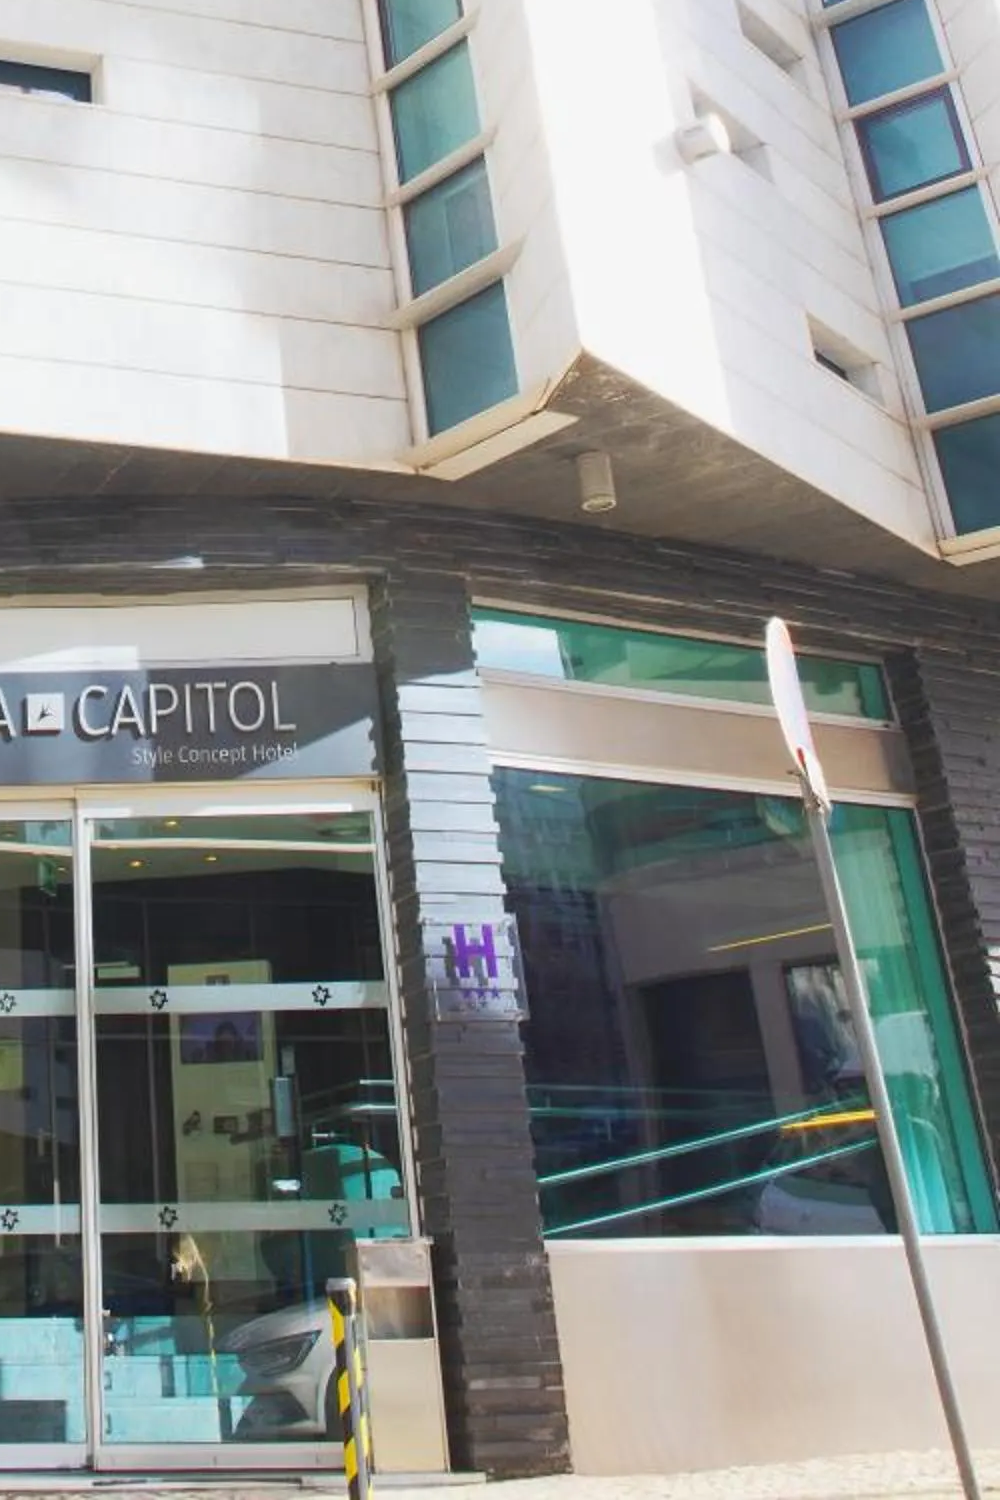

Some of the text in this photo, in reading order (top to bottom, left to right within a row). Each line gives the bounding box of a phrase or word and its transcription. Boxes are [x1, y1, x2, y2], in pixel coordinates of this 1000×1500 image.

[78, 680, 297, 736] CAPITOL
[133, 742, 298, 768] Style Concept Hotel
[453, 923, 498, 978] H
